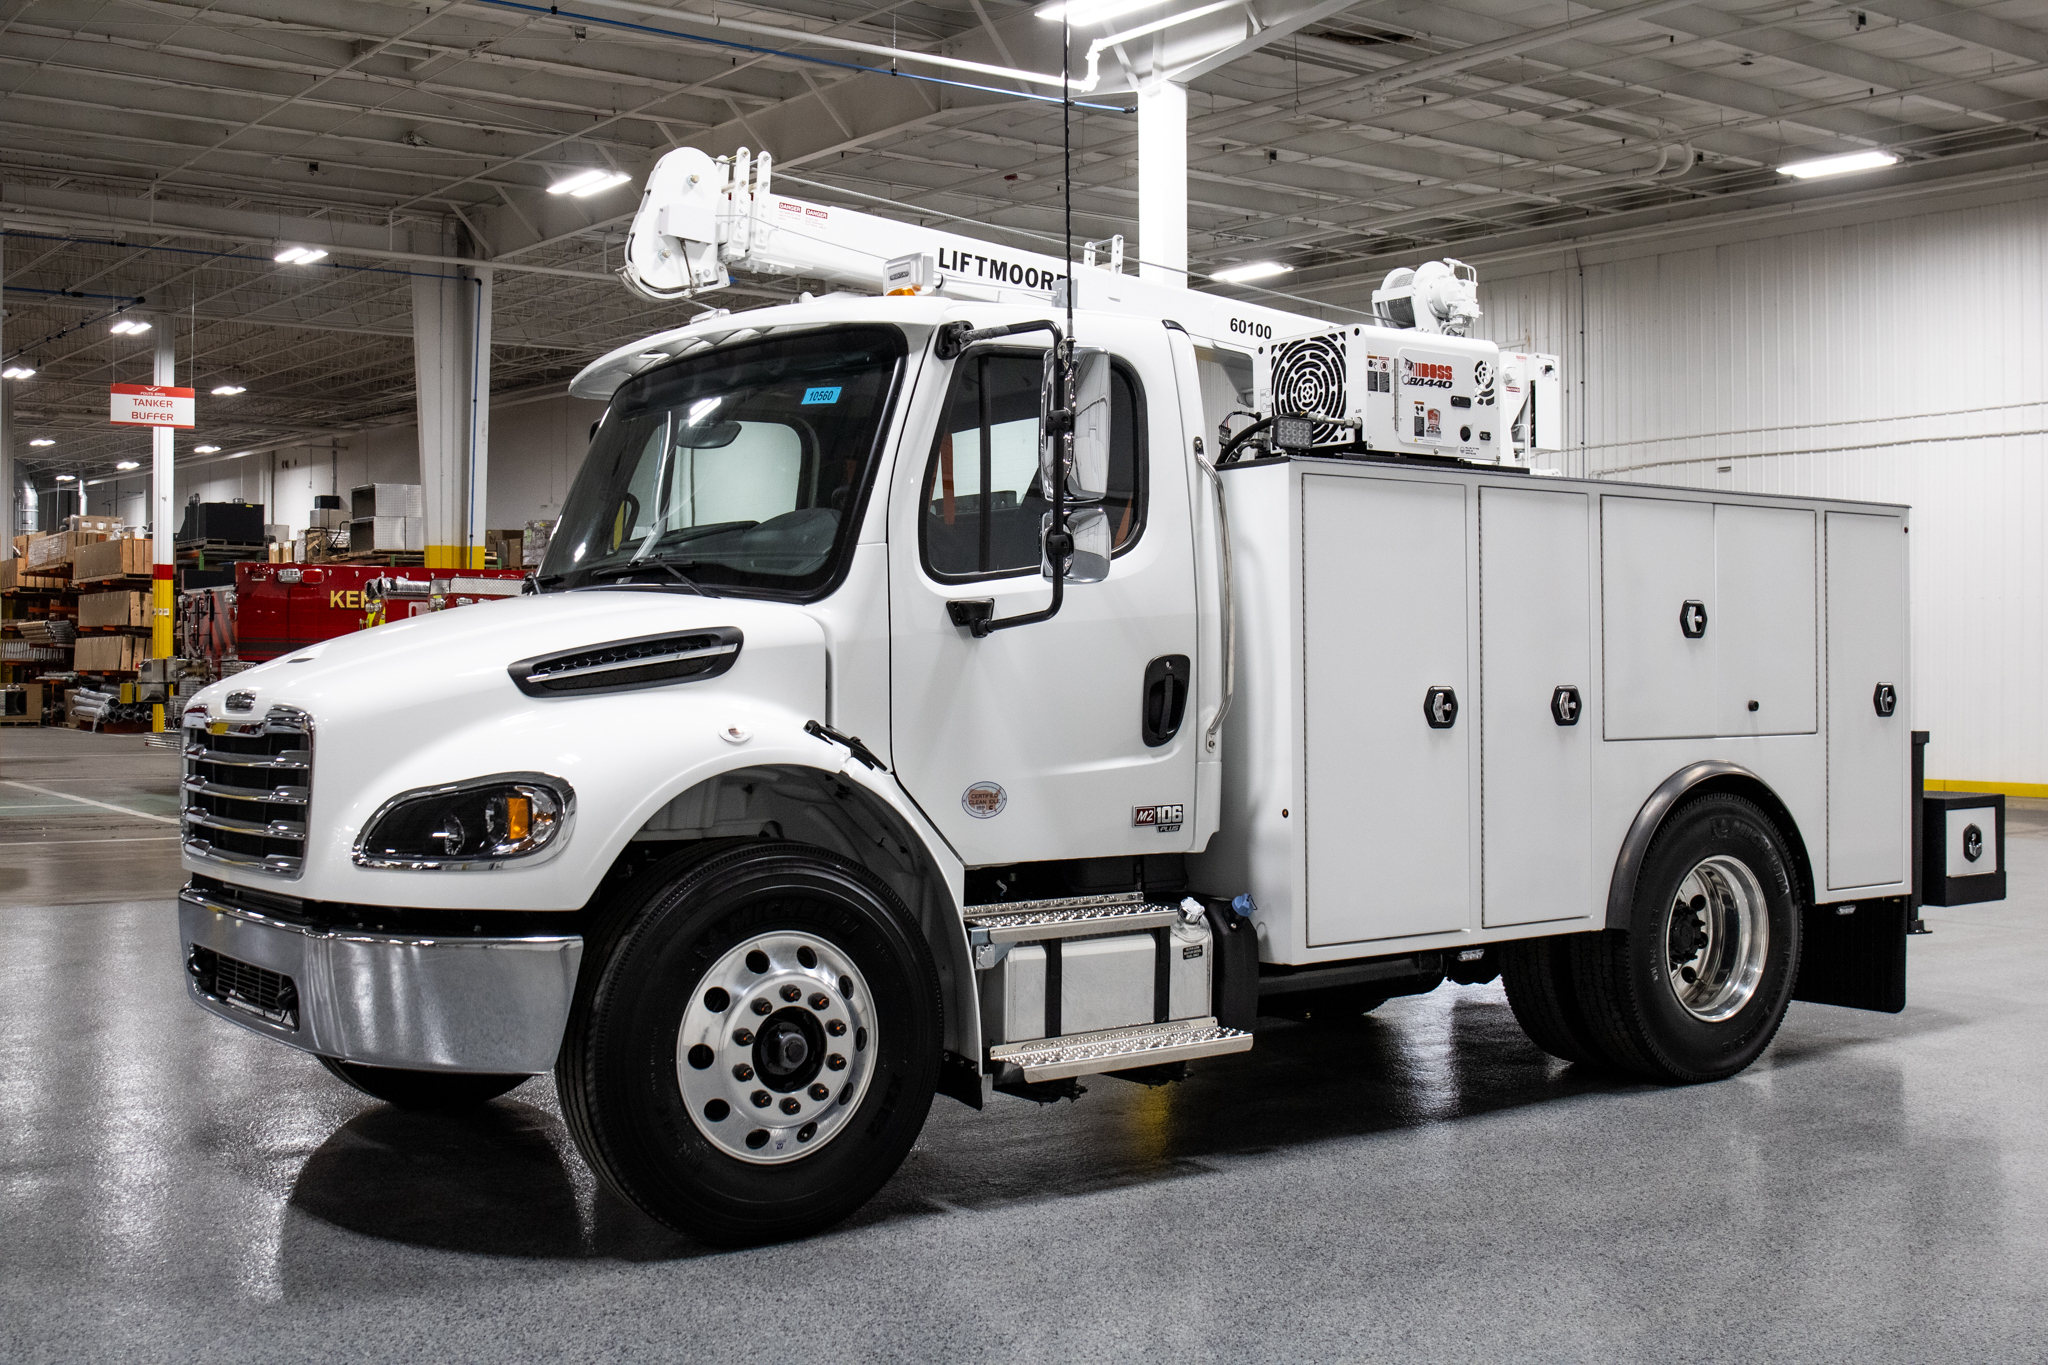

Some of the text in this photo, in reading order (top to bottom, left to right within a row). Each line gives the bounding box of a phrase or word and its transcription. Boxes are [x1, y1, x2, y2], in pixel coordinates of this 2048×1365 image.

[780, 203, 800, 212] DANGER
[806, 210, 827, 218] DANGER
[1230, 317, 1272, 340] 60100
[1421, 362, 1453, 381] BOSS
[809, 390, 834, 401] 10560
[132, 398, 174, 408] TANKER
[131, 411, 174, 422] BUFFER
[1136, 805, 1182, 824] M2 106
